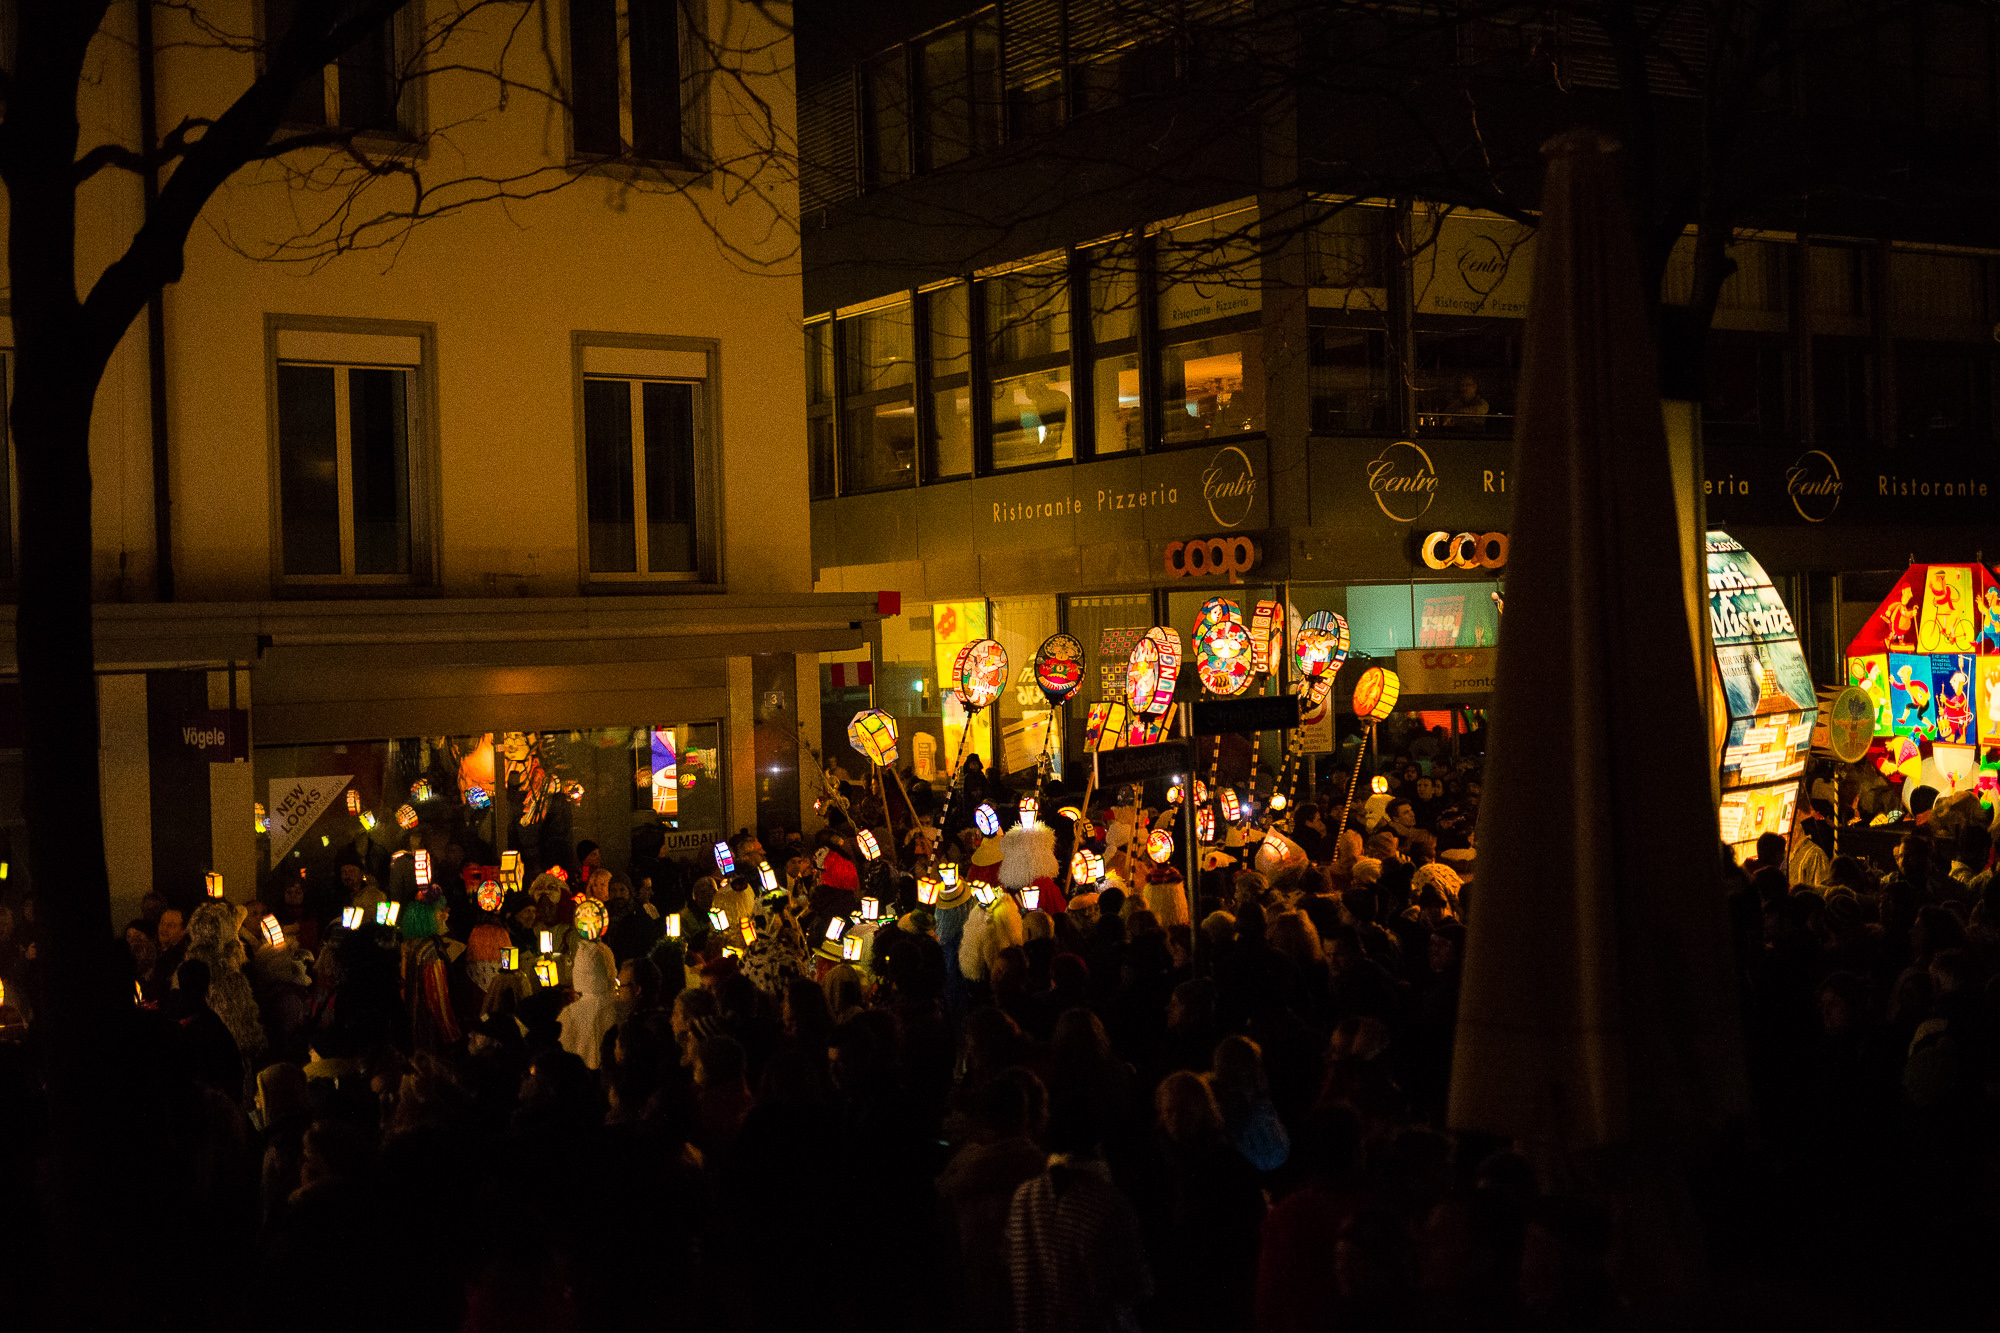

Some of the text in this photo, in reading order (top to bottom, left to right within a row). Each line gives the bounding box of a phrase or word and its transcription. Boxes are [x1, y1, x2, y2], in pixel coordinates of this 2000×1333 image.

[1173, 299, 1249, 321] Ristorante Pizzeria
[1492, 299, 1527, 311] Pizzeri
[1202, 467, 1257, 500] Centro
[1366, 460, 1505, 493] Centro Ri
[1703, 473, 1750, 496] eria
[1785, 466, 1988, 497] Centro Ristorante
[992, 483, 1178, 524] Ristorante Pizzeria
[1164, 535, 1255, 584] coop
[1421, 531, 1511, 570] coo
[770, 693, 778, 705] 3
[182, 726, 226, 749] Vögele
[276, 783, 305, 817] NEW
[280, 788, 321, 834] LOOKS
[667, 832, 719, 849] UMBAU
